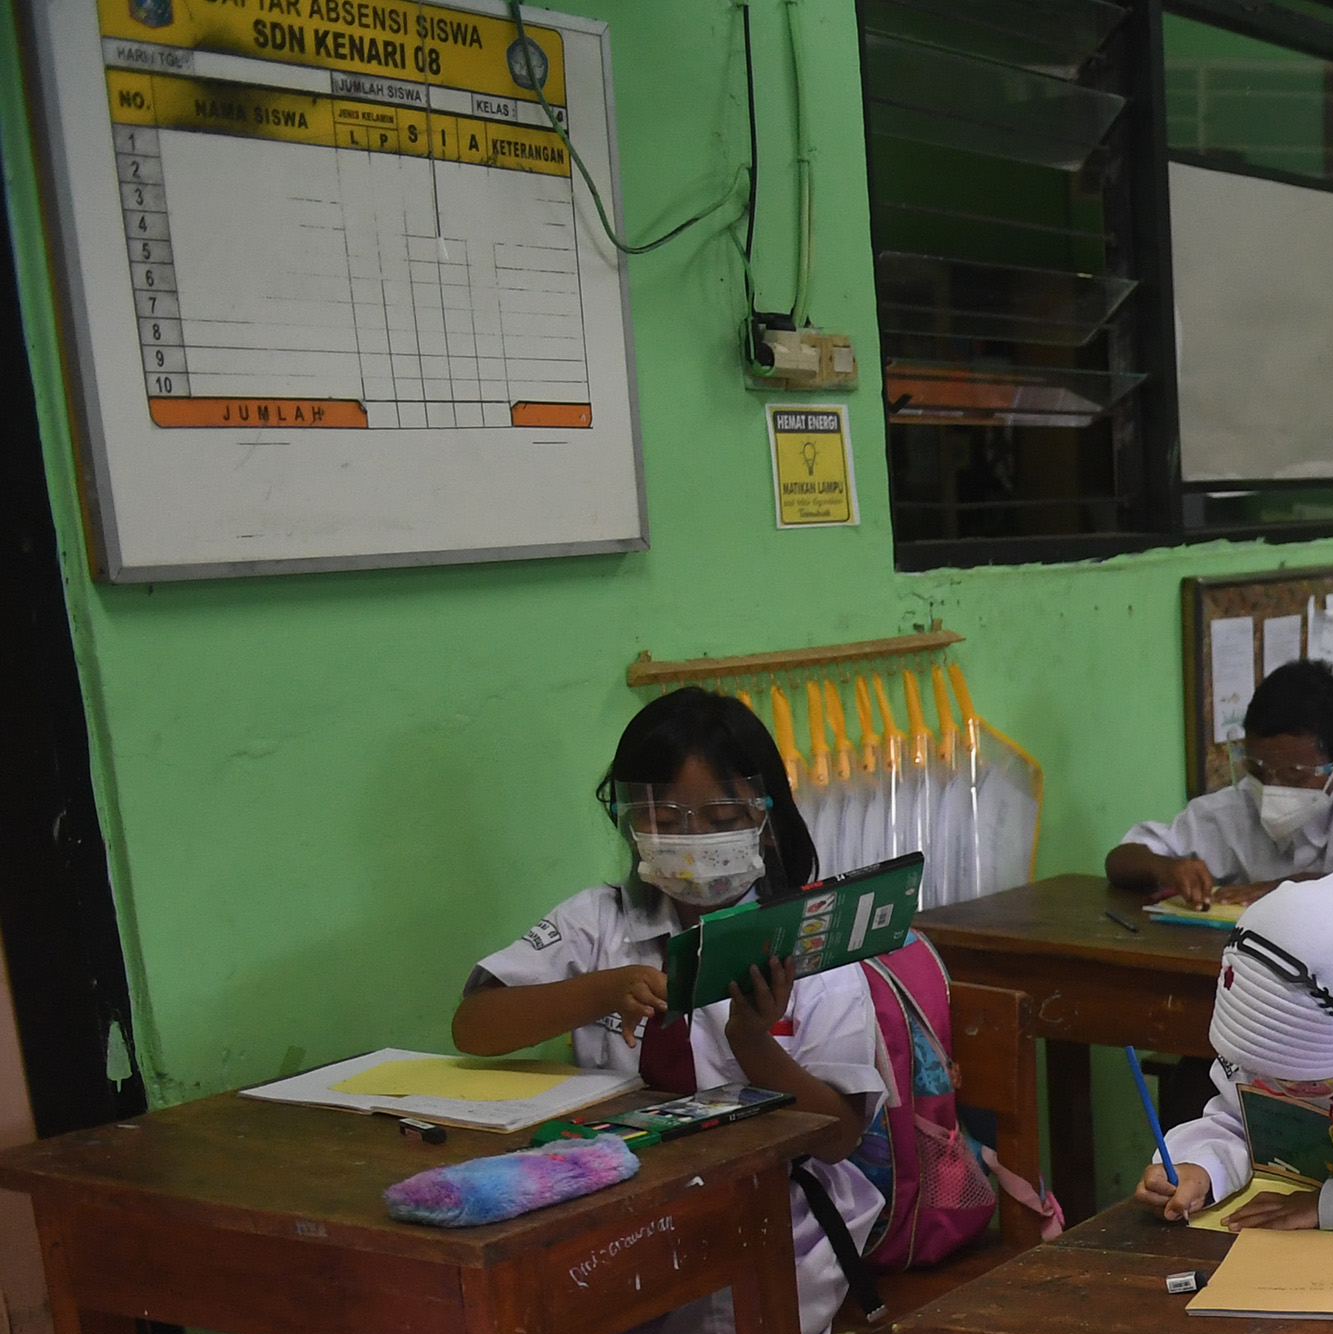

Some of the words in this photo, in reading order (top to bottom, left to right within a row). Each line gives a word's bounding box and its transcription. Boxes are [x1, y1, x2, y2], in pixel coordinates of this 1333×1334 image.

[205, 0, 301, 17] TAR
[309, 0, 408, 36] ABSENSI
[416, 13, 483, 49] SISWA
[117, 47, 148, 64] HARI
[253, 18, 306, 54] SDN
[313, 28, 406, 70] KENARI
[414, 45, 442, 76] 08
[339, 78, 384, 96] JUMLAH
[387, 85, 422, 102] SISWA
[118, 90, 151, 110] NO.
[476, 100, 510, 117] KELAS
[195, 99, 248, 122] NAMA
[254, 105, 310, 129] SISWA
[361, 111, 395, 125] KELAMIN
[128, 133, 136, 152] 1
[350, 130, 360, 146] L
[379, 133, 388, 147] P
[408, 124, 419, 144] S
[468, 134, 480, 152] A
[491, 138, 565, 165] KETERANGAN
[131, 160, 141, 180] 2
[134, 187, 144, 206] 3
[138, 214, 148, 233] 4
[142, 242, 152, 260] 5
[145, 269, 155, 287] 6
[148, 296, 157, 314] 7
[152, 323, 162, 341] 8
[155, 350, 165, 368] 9
[155, 376, 172, 394] 10
[223, 405, 323, 422] JUMLAH
[777, 414, 806, 430] HEMAT
[808, 415, 838, 431] ENERGI
[783, 481, 816, 495] MATIKAN
[818, 481, 844, 494] LAMPU
